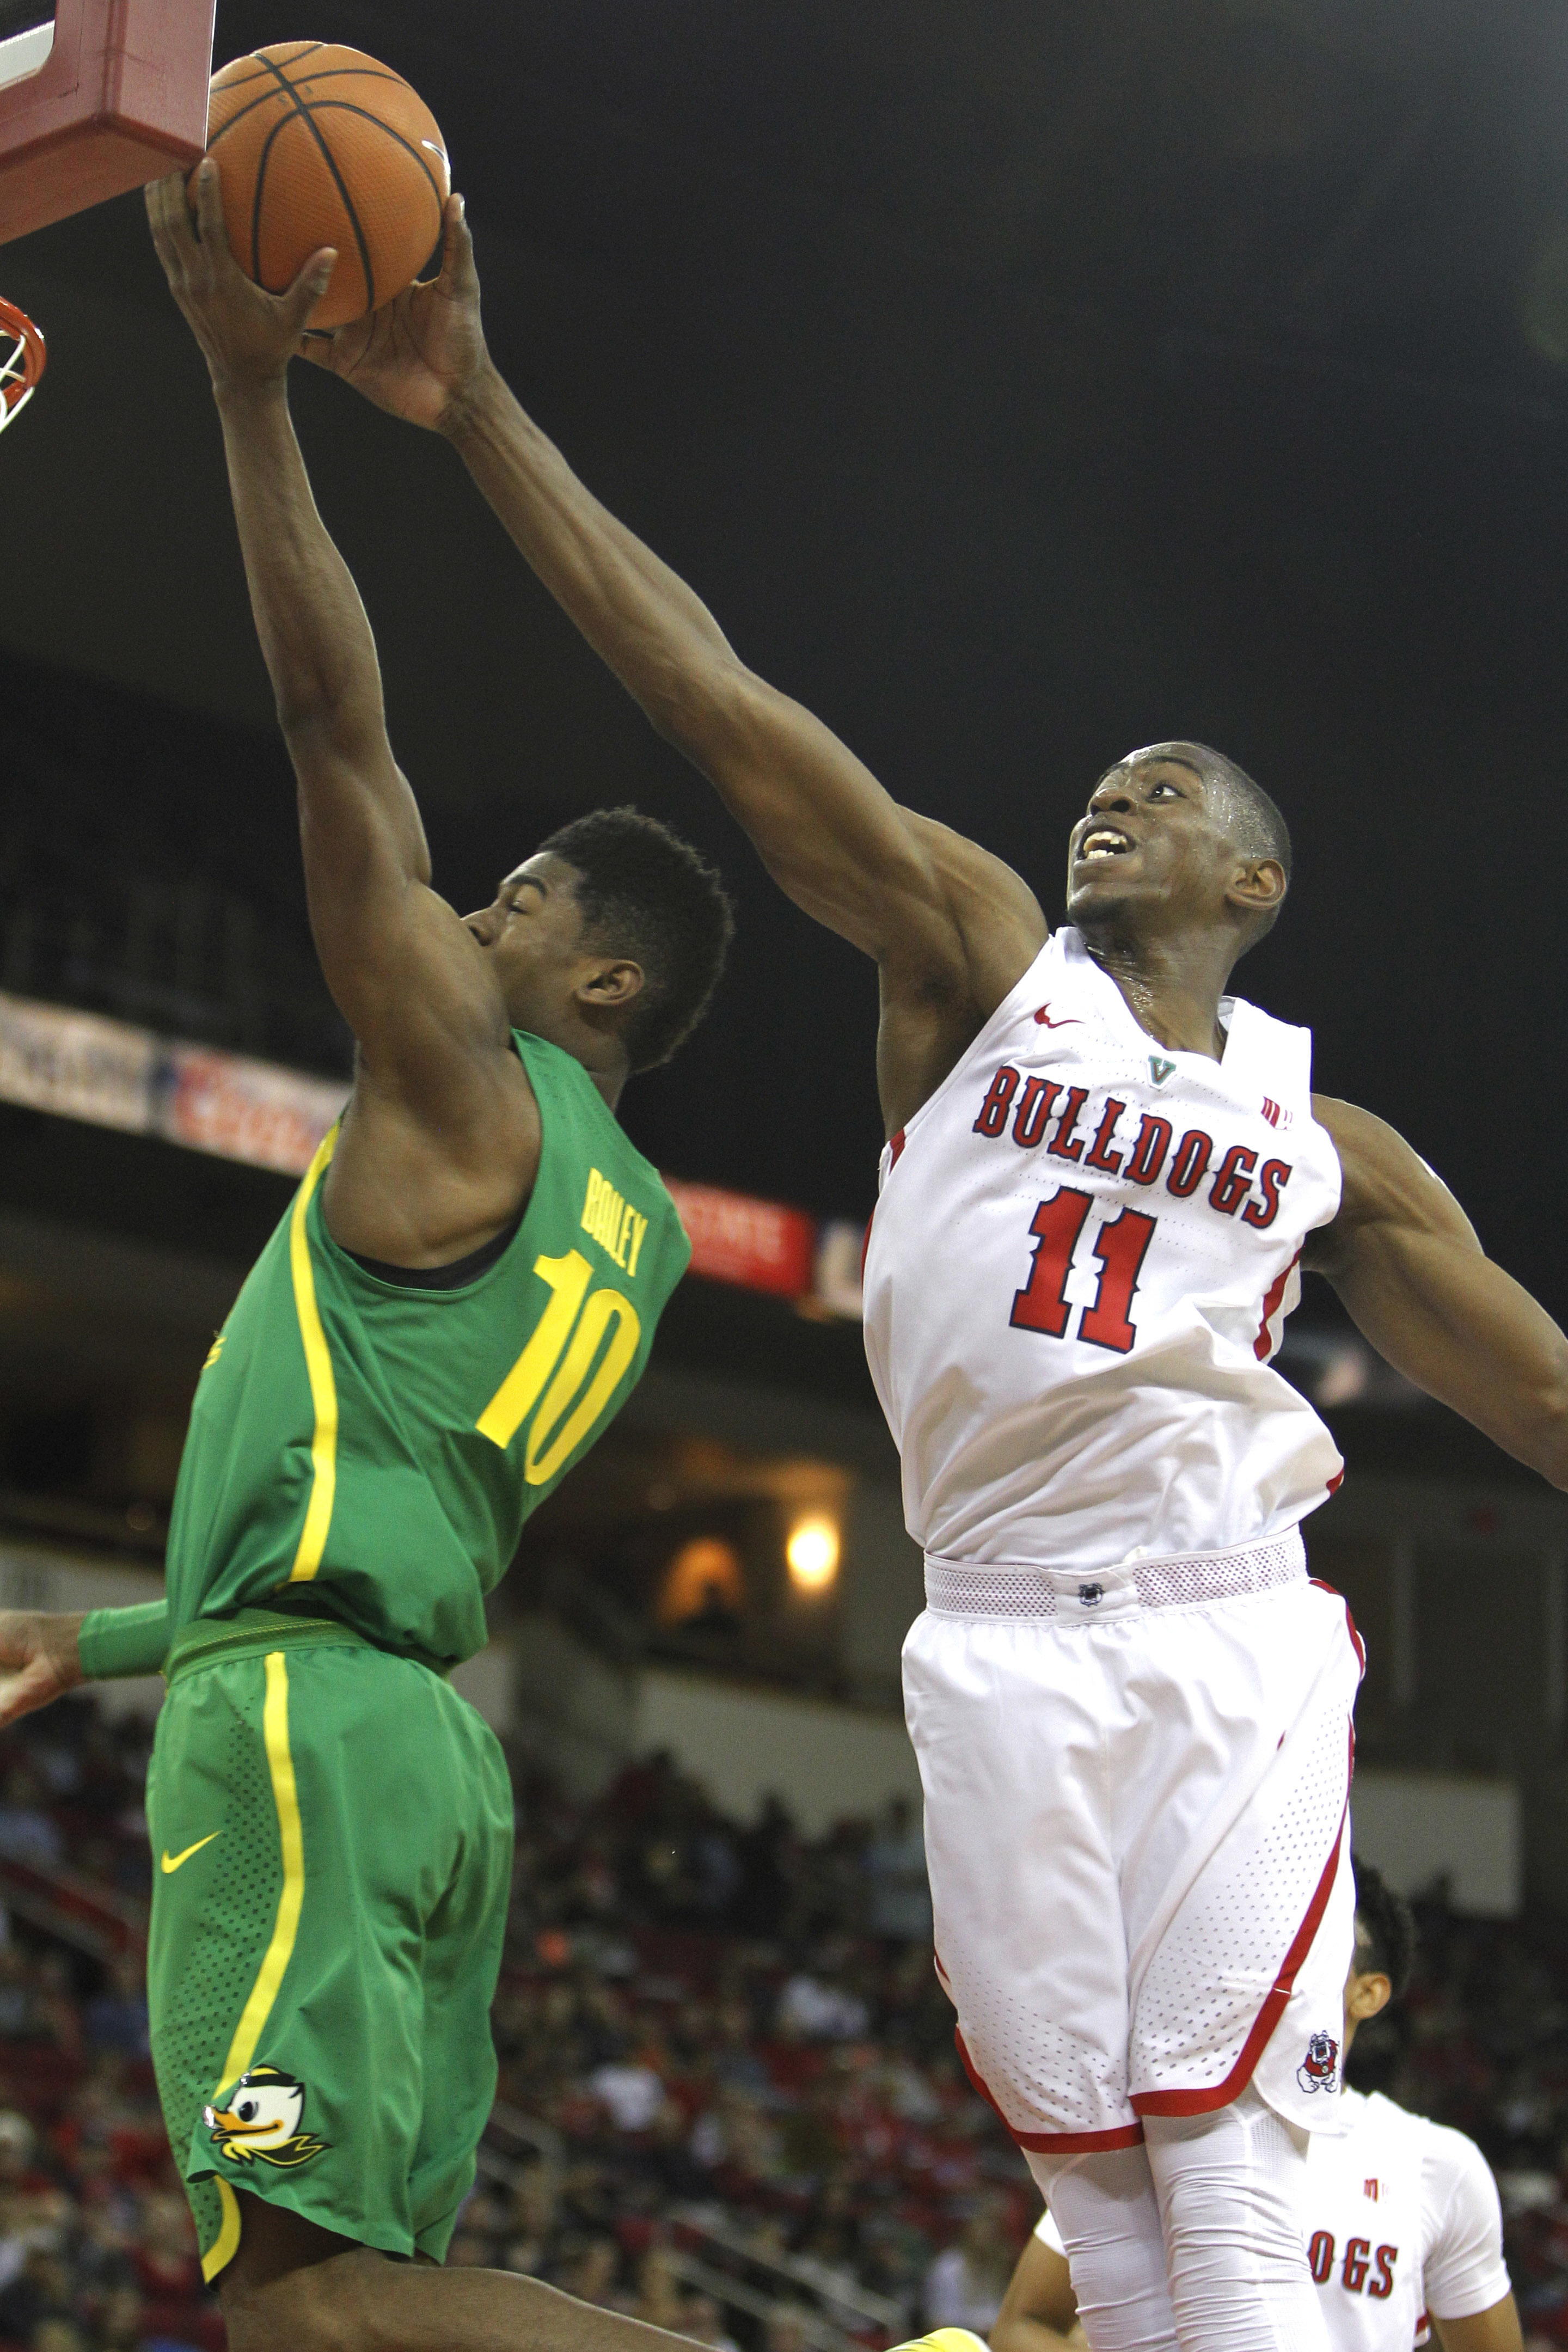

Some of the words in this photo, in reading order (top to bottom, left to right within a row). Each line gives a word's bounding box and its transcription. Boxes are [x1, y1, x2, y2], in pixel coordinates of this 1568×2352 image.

[580, 1167, 648, 1277] BAILEY
[972, 1065, 1293, 1229] BULLDOGS
[1009, 1185, 1158, 1355] 11
[475, 1249, 641, 1485] 10
